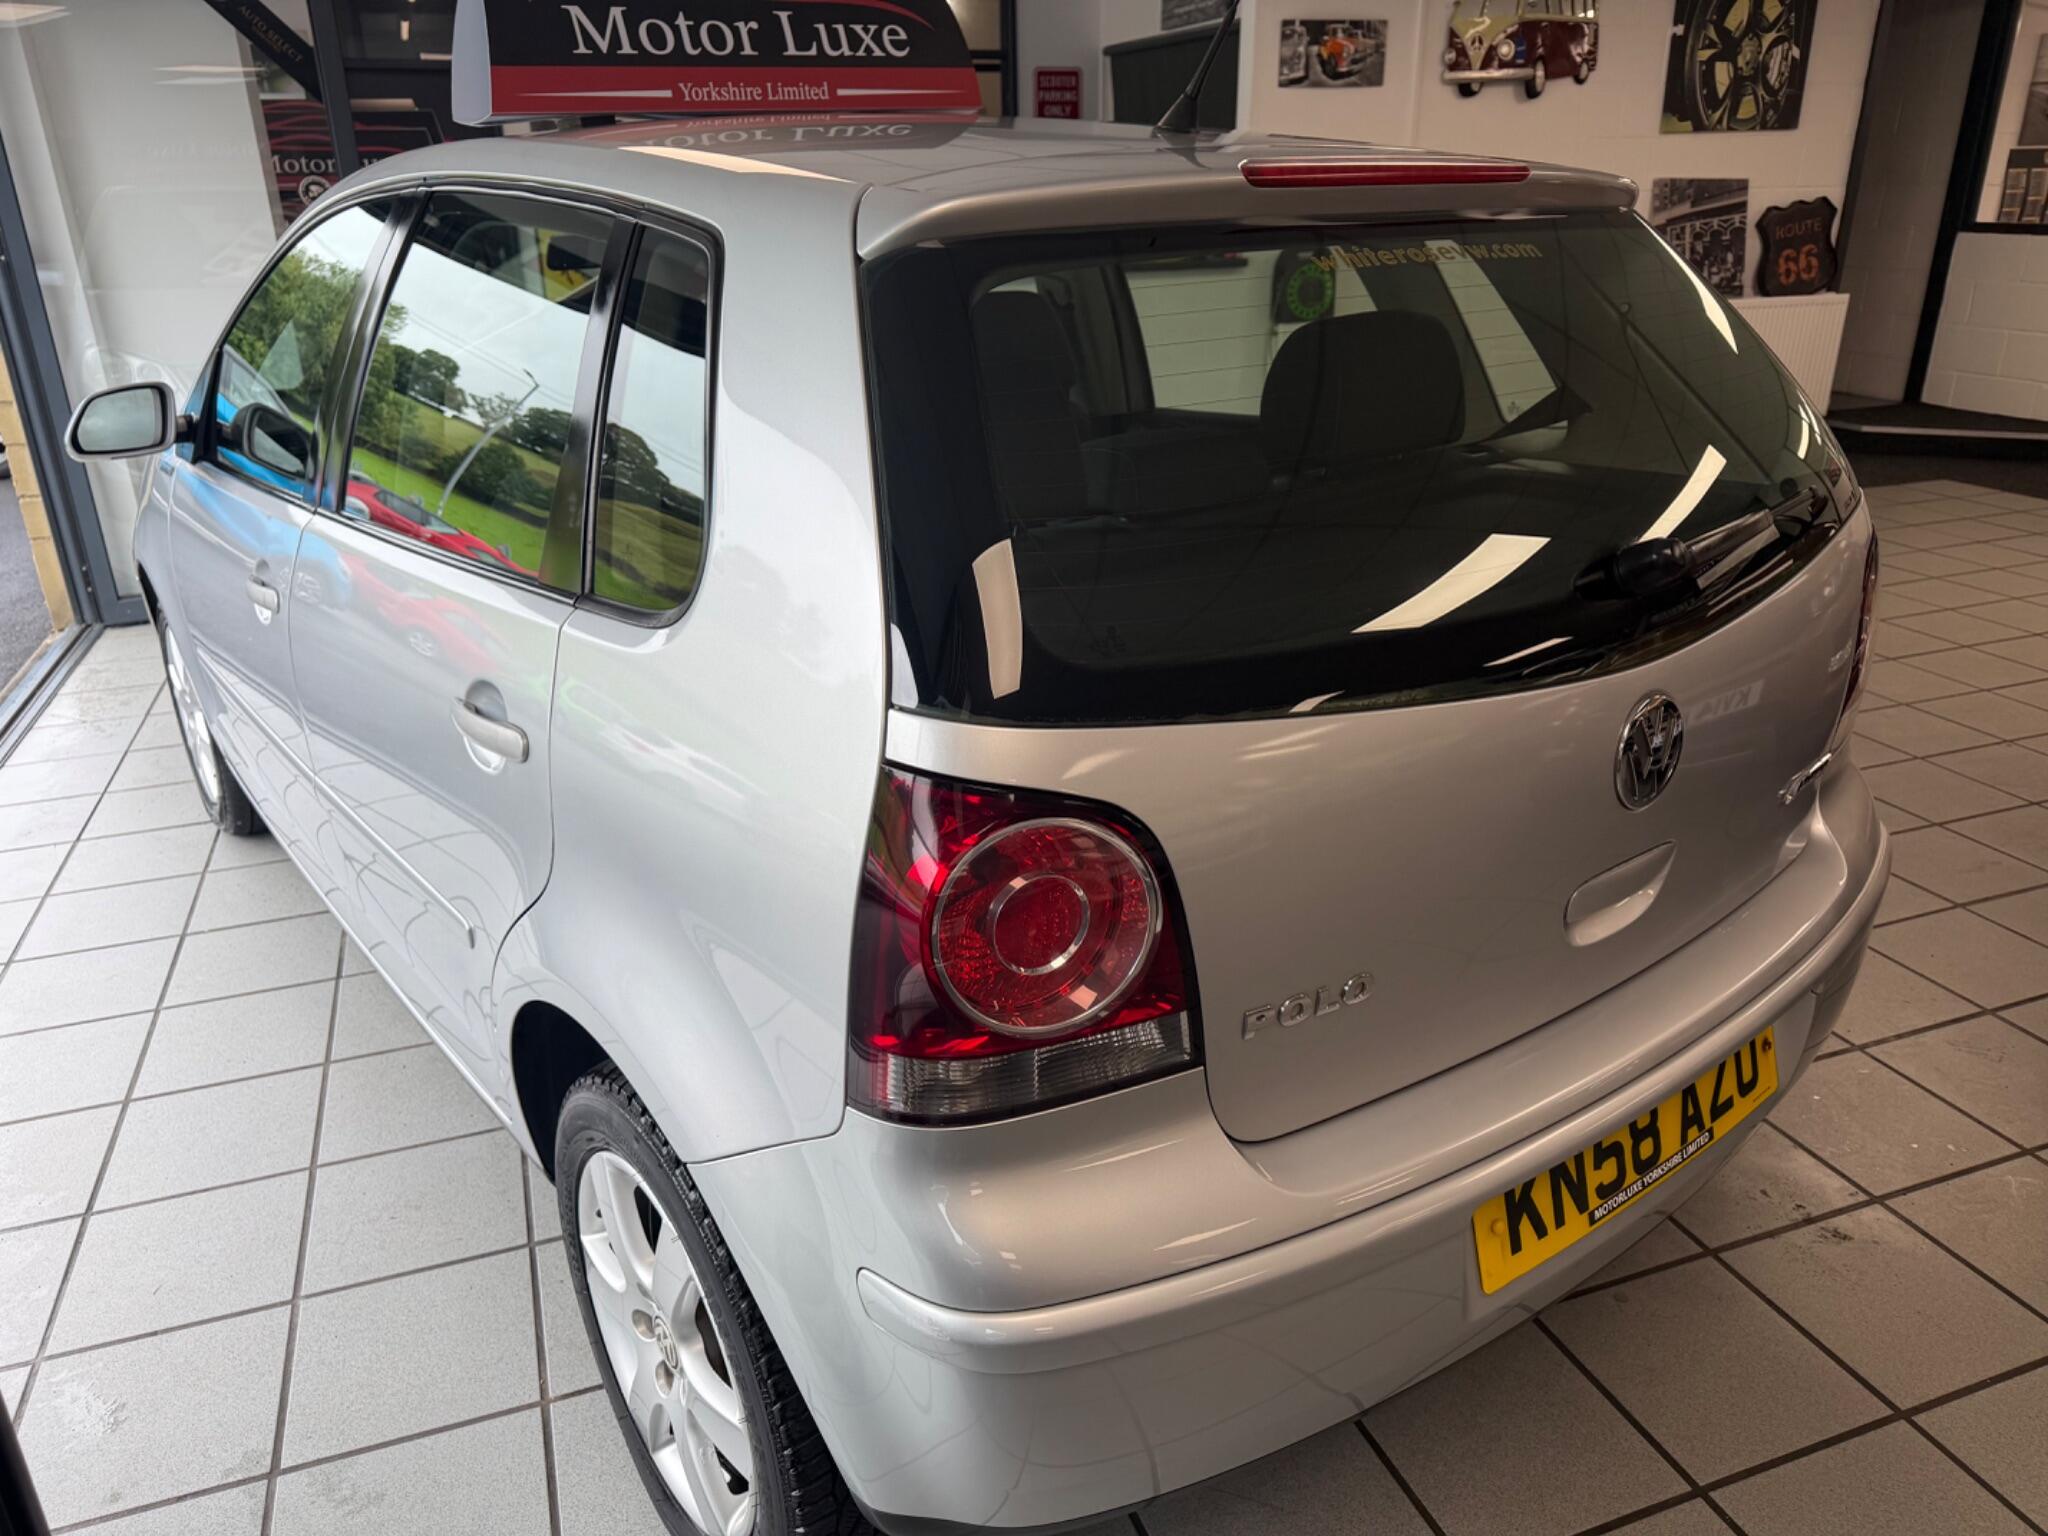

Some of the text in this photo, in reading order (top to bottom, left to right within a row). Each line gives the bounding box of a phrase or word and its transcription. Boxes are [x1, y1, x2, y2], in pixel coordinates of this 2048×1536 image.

[561, 5, 911, 57] Motor Luxe
[679, 81, 829, 101] Yorkshire Limited
[1775, 218, 1823, 241] ROUTE
[1778, 244, 1820, 287] 66
[1241, 972, 1375, 1040] POLO
[1503, 1107, 1662, 1257] KN58
[1594, 1132, 1710, 1220] MOTORLUXE YORKSHIRE LIMITED
